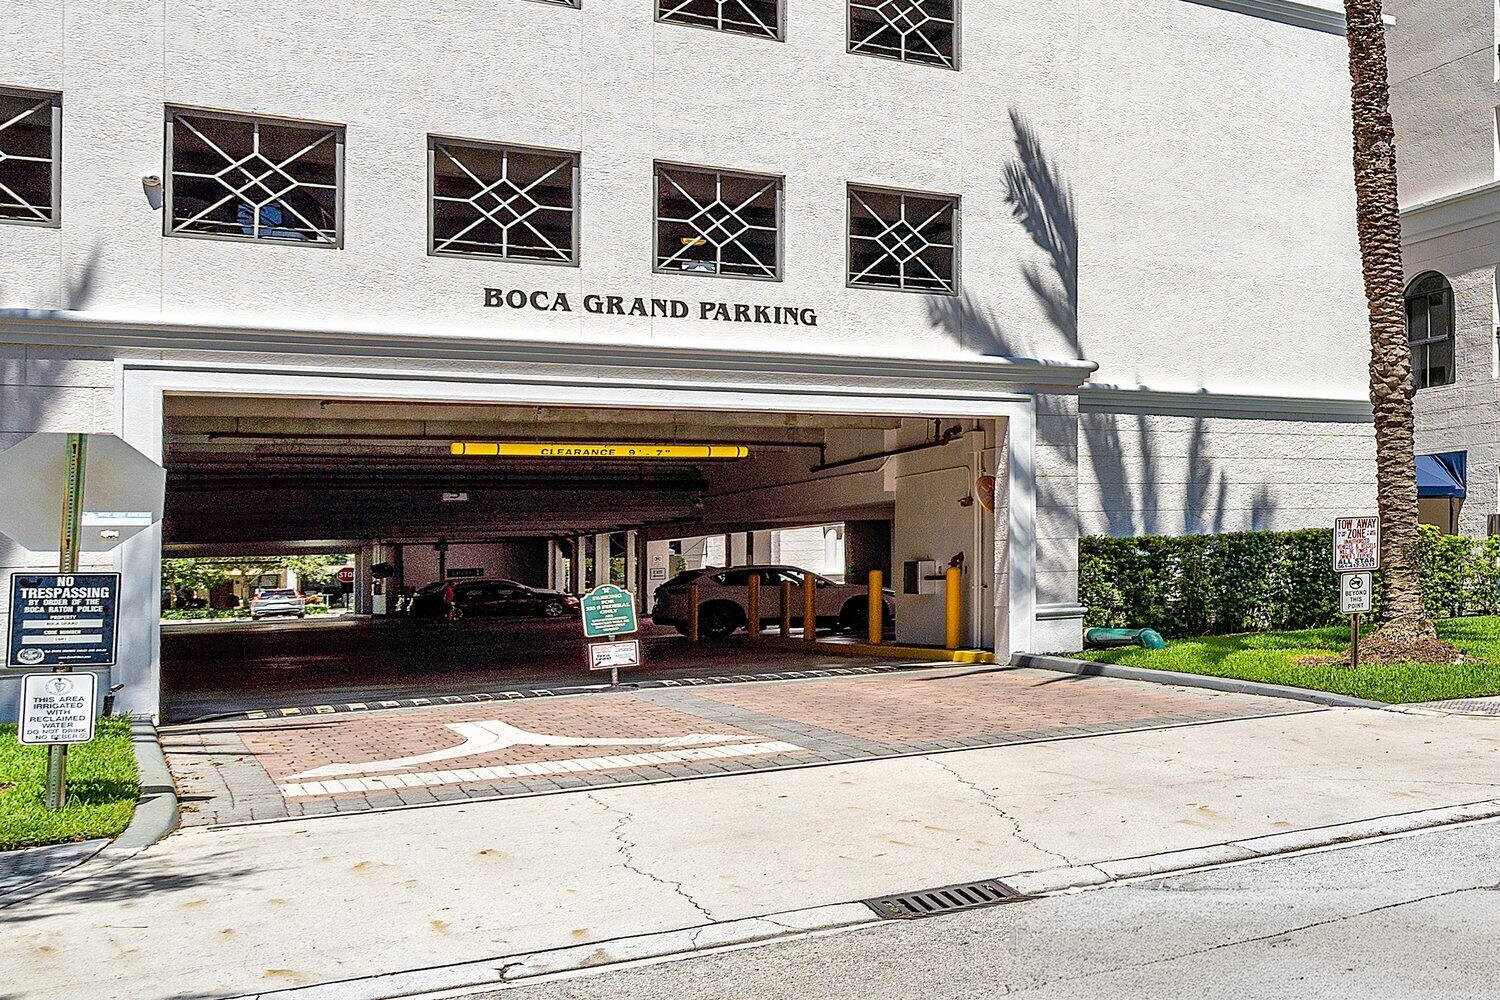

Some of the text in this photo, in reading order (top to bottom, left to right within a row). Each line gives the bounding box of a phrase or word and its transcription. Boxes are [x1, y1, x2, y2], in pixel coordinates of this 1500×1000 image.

[483, 287, 819, 326] BOCA GRAND PARKING
[540, 448, 616, 456] CLEARANCE
[1338, 518, 1377, 530] TOW AWAY
[1347, 529, 1367, 539] ZONE
[56, 576, 75, 587] NO
[20, 587, 110, 599] TRESPASSING
[1345, 589, 1367, 597] BEYOND
